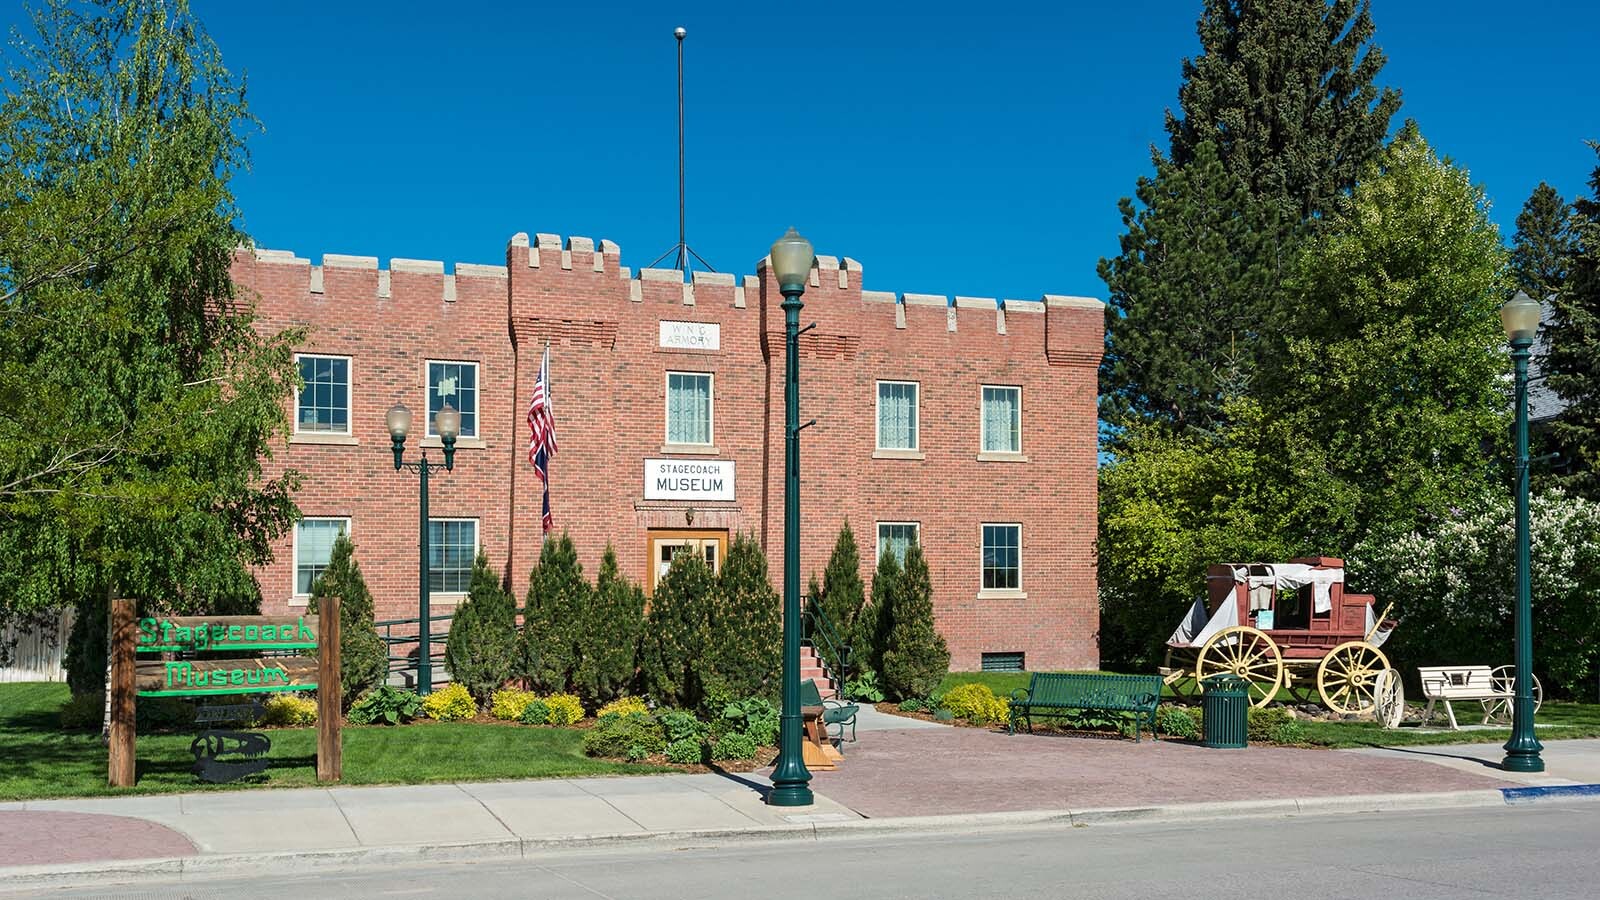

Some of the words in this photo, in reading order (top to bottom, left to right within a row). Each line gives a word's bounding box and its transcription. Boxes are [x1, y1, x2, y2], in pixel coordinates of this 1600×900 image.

[660, 464, 720, 474] STAGECOACH
[657, 478, 723, 491] MUSEUM
[139, 616, 315, 650] Stagecoach
[164, 661, 289, 687] Museum
